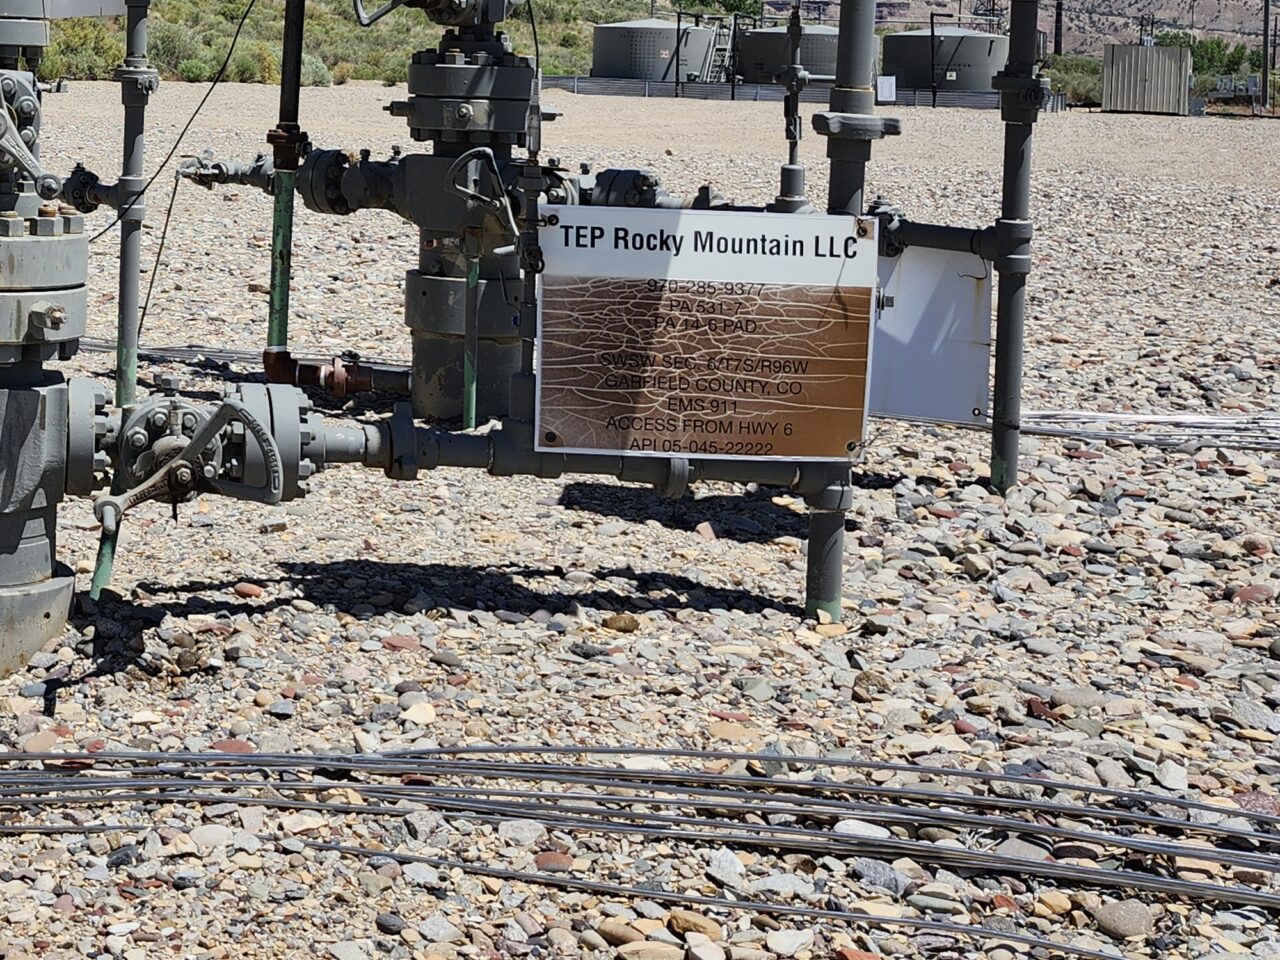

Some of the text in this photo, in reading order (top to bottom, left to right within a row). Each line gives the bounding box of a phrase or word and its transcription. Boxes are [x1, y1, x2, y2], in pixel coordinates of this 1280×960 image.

[560, 225, 858, 259] TEP Rocky Mountain LLC
[647, 278, 765, 296] 970-285-9377
[669, 300, 743, 315] PA 531-7
[654, 315, 758, 333] PA 14-6 PAD
[600, 353, 657, 368] SWSW
[661, 355, 701, 371] SEC.
[604, 374, 803, 396] GARFIELD COUNTY, CO
[667, 397, 738, 413] EMS 911
[606, 415, 793, 436] ACCESS FROM HWY 6
[629, 438, 774, 456] API 05-045-22222
